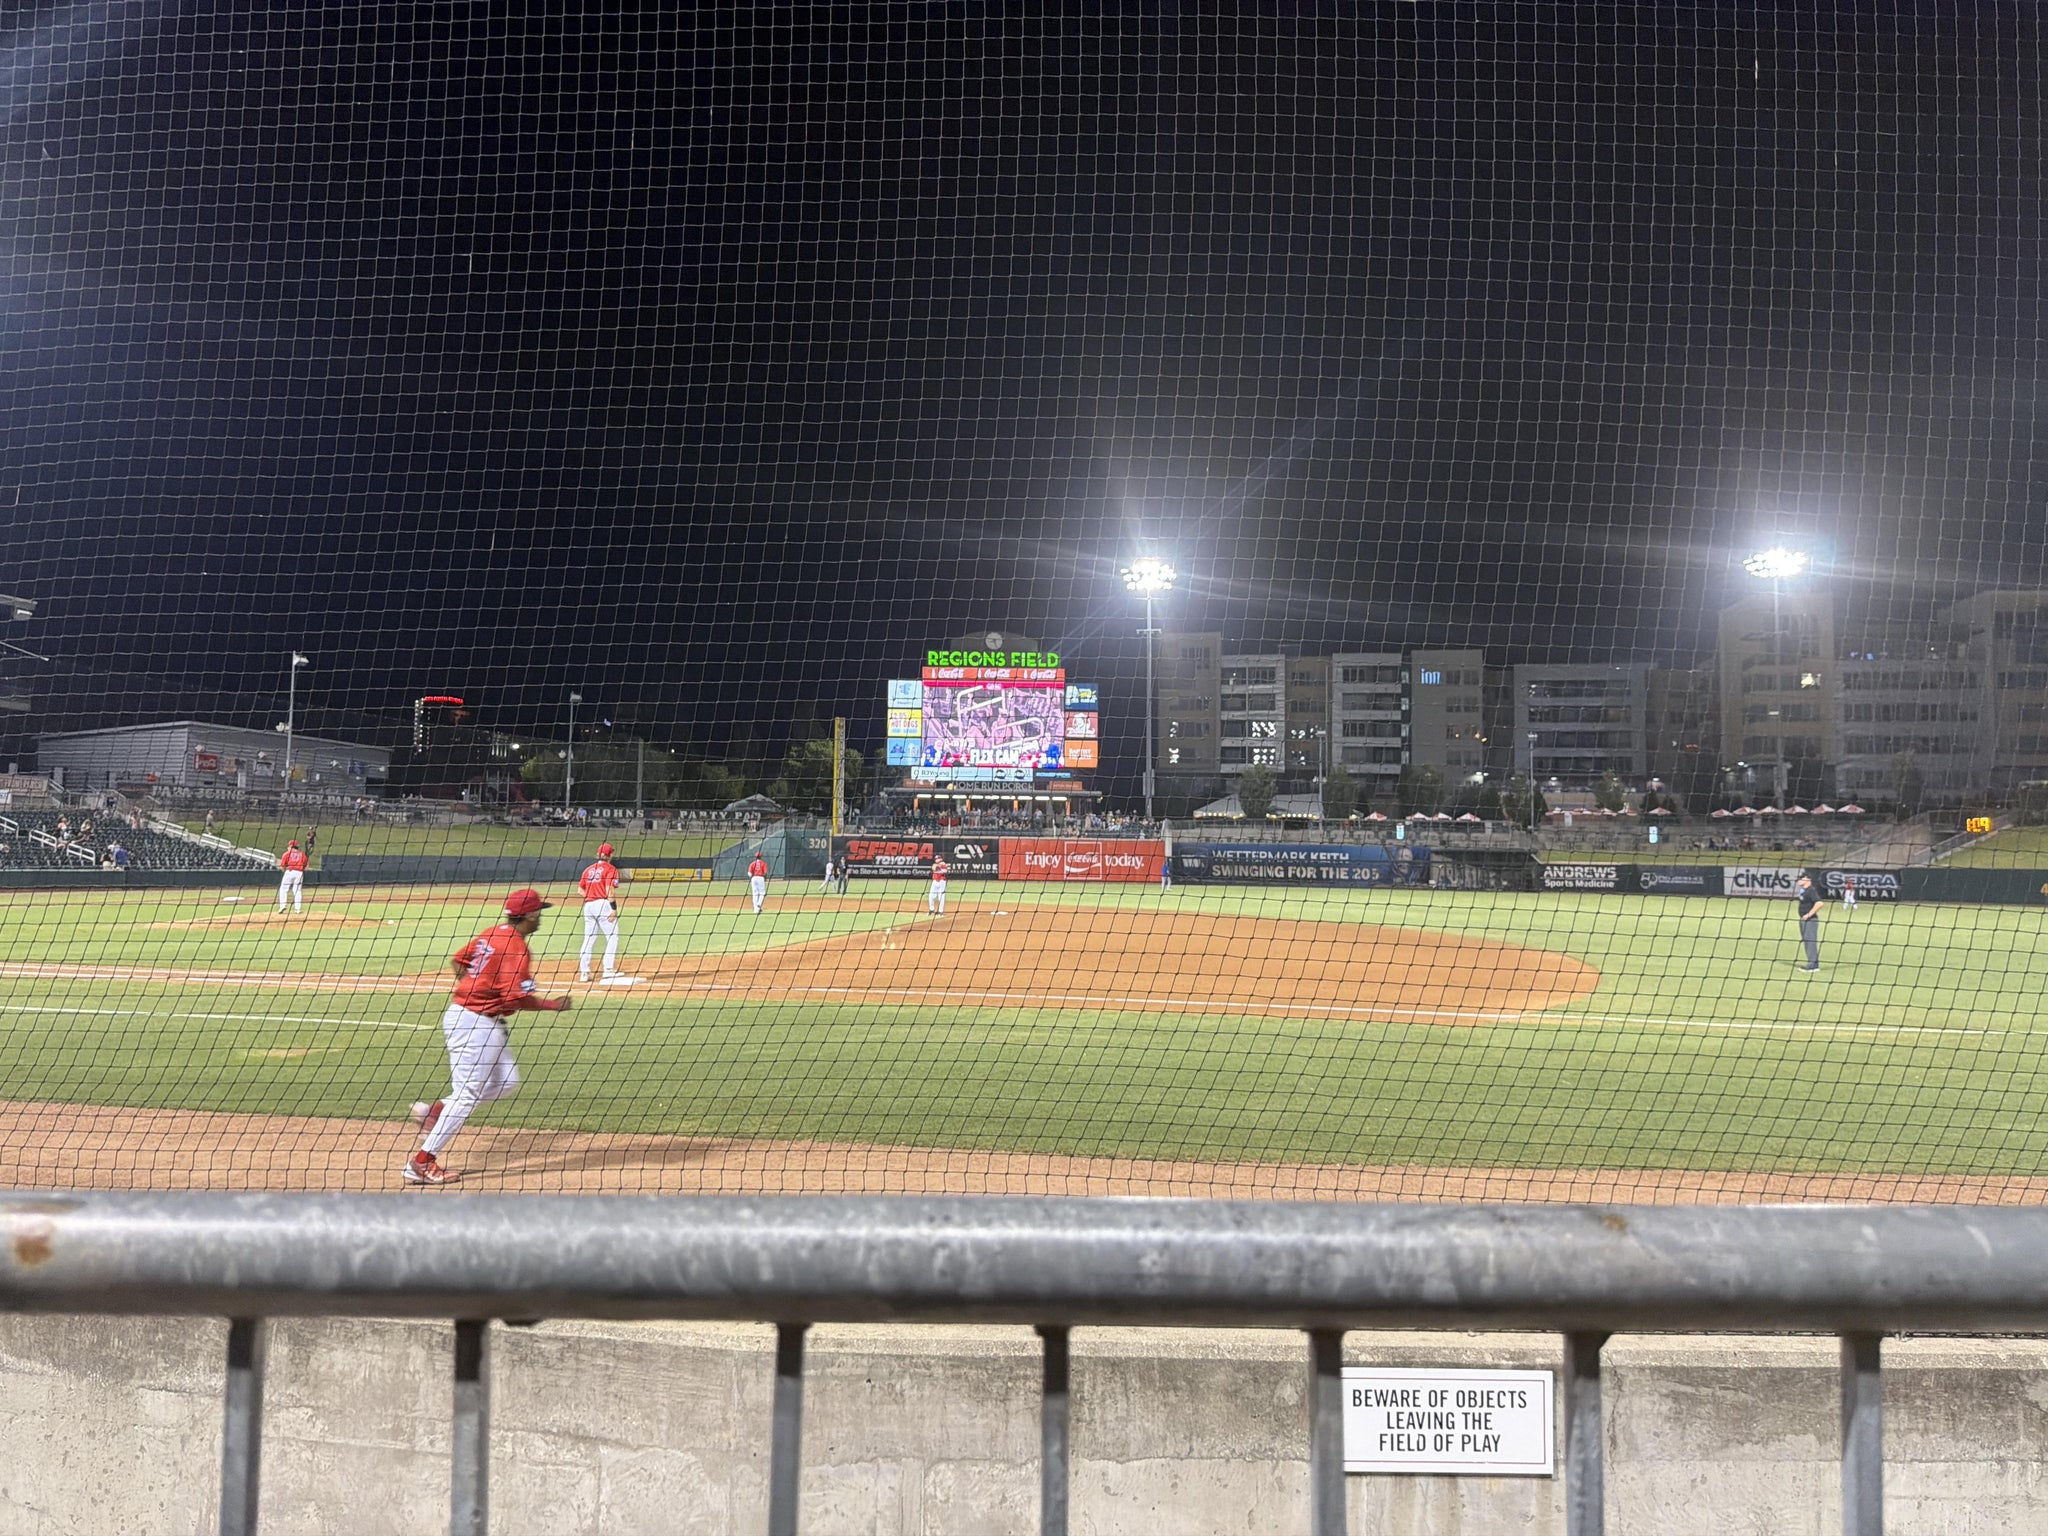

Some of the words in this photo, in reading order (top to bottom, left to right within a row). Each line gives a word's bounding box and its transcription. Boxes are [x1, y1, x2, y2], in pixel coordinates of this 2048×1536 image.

[927, 651, 1006, 667] REGIONS
[1011, 652, 1060, 668] FIELD
[981, 782, 1000, 790] RUN
[1003, 782, 1035, 791] PORCH
[593, 809, 644, 818] JOHNS
[808, 838, 827, 849] 320
[847, 840, 934, 860] SERRA
[874, 855, 919, 866] TOYOTA
[1025, 852, 1061, 868] Enjoy
[1104, 853, 1145, 869] today.
[1310, 852, 1350, 864] KEITH
[898, 867, 913, 875] Auto
[972, 863, 998, 871] WIDE
[1212, 865, 1285, 878] SWINGING
[1287, 866, 1317, 879] FOR
[1320, 867, 1349, 879] THE
[1543, 866, 1617, 879] ANDREWS
[1545, 879, 1574, 889] Sports
[1575, 880, 1615, 889] Medicine
[1827, 889, 1896, 898] HYNDAI
[1352, 1389, 1421, 1407] BEWARE
[1428, 1390, 1449, 1407] OF
[1456, 1390, 1527, 1409] OBJECTS
[1386, 1411, 1455, 1430] LEAVING
[1462, 1412, 1493, 1430] THE
[1379, 1433, 1426, 1452] FIELD
[1434, 1434, 1454, 1452] OF
[1461, 1434, 1501, 1453] PLAY
